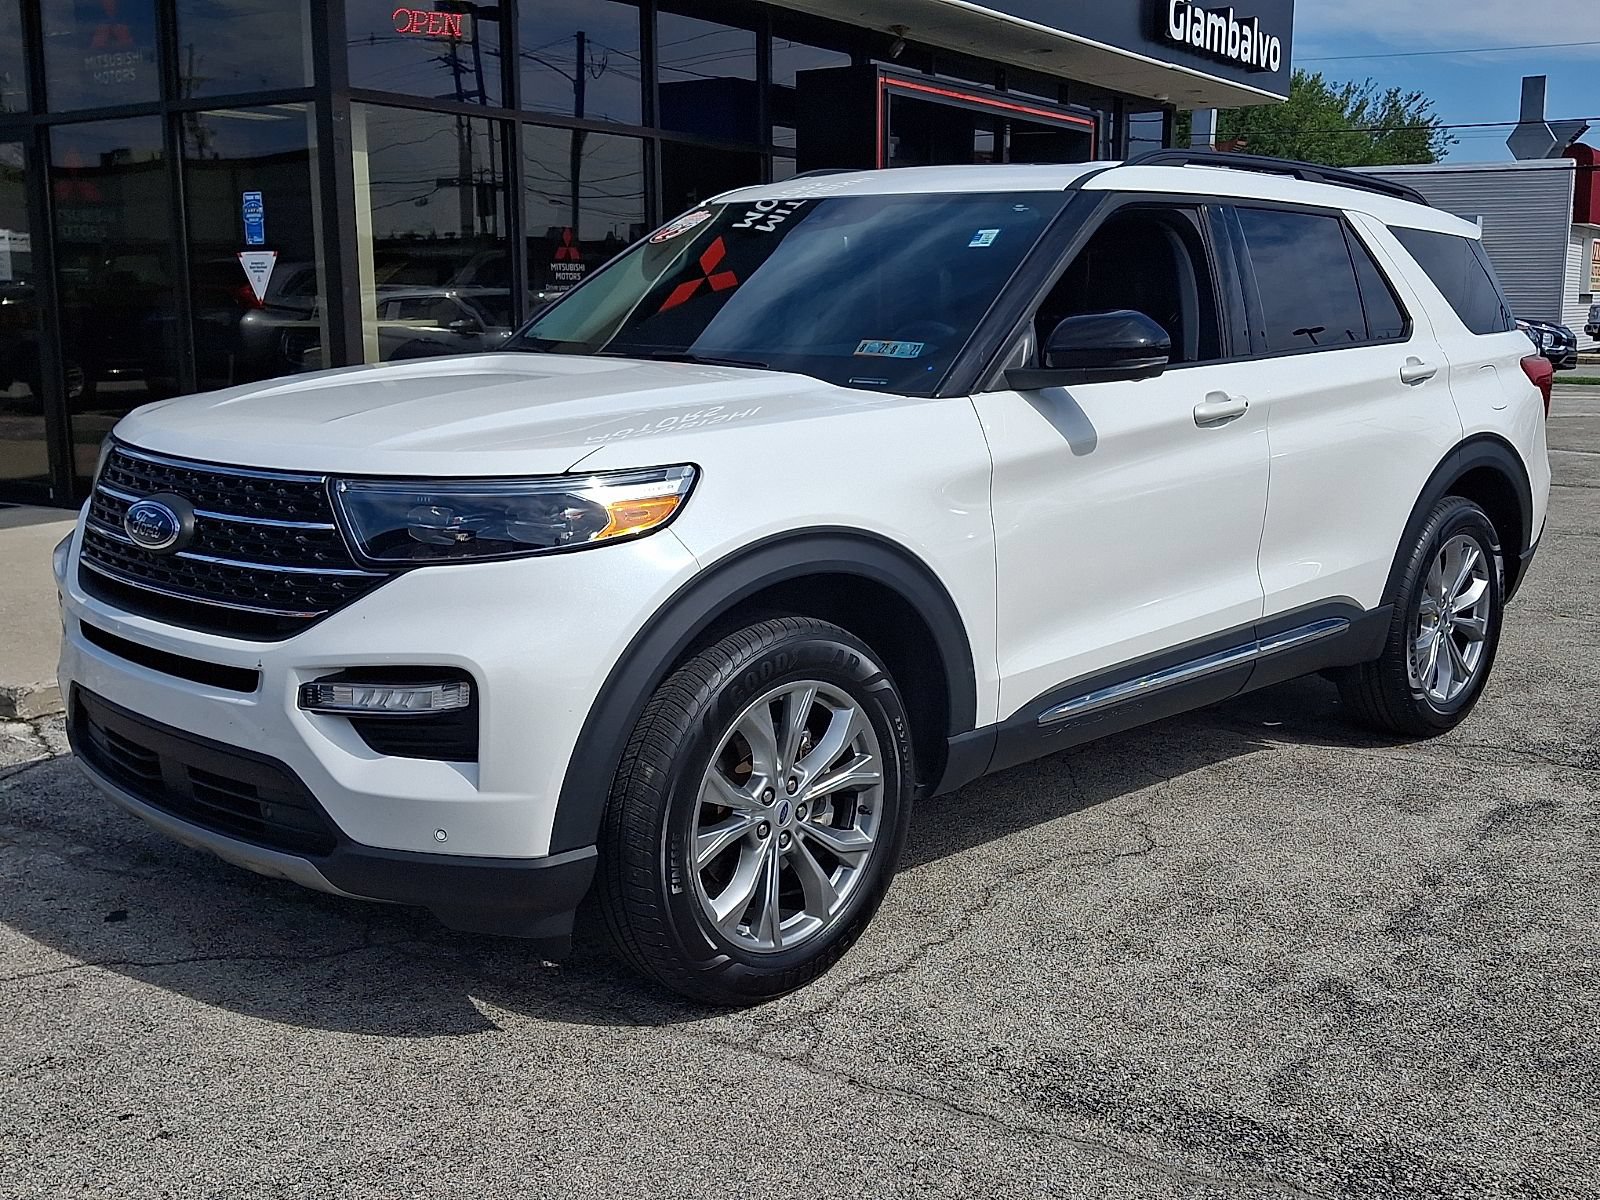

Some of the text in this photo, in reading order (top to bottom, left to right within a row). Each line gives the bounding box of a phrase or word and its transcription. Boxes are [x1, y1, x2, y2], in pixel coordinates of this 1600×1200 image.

[392, 8, 463, 37] OPEN
[1169, 0, 1281, 72] Giambalvo
[550, 263, 585, 271] MITSUBISHI
[555, 272, 581, 280] MOTORS
[132, 509, 163, 539] Ford
